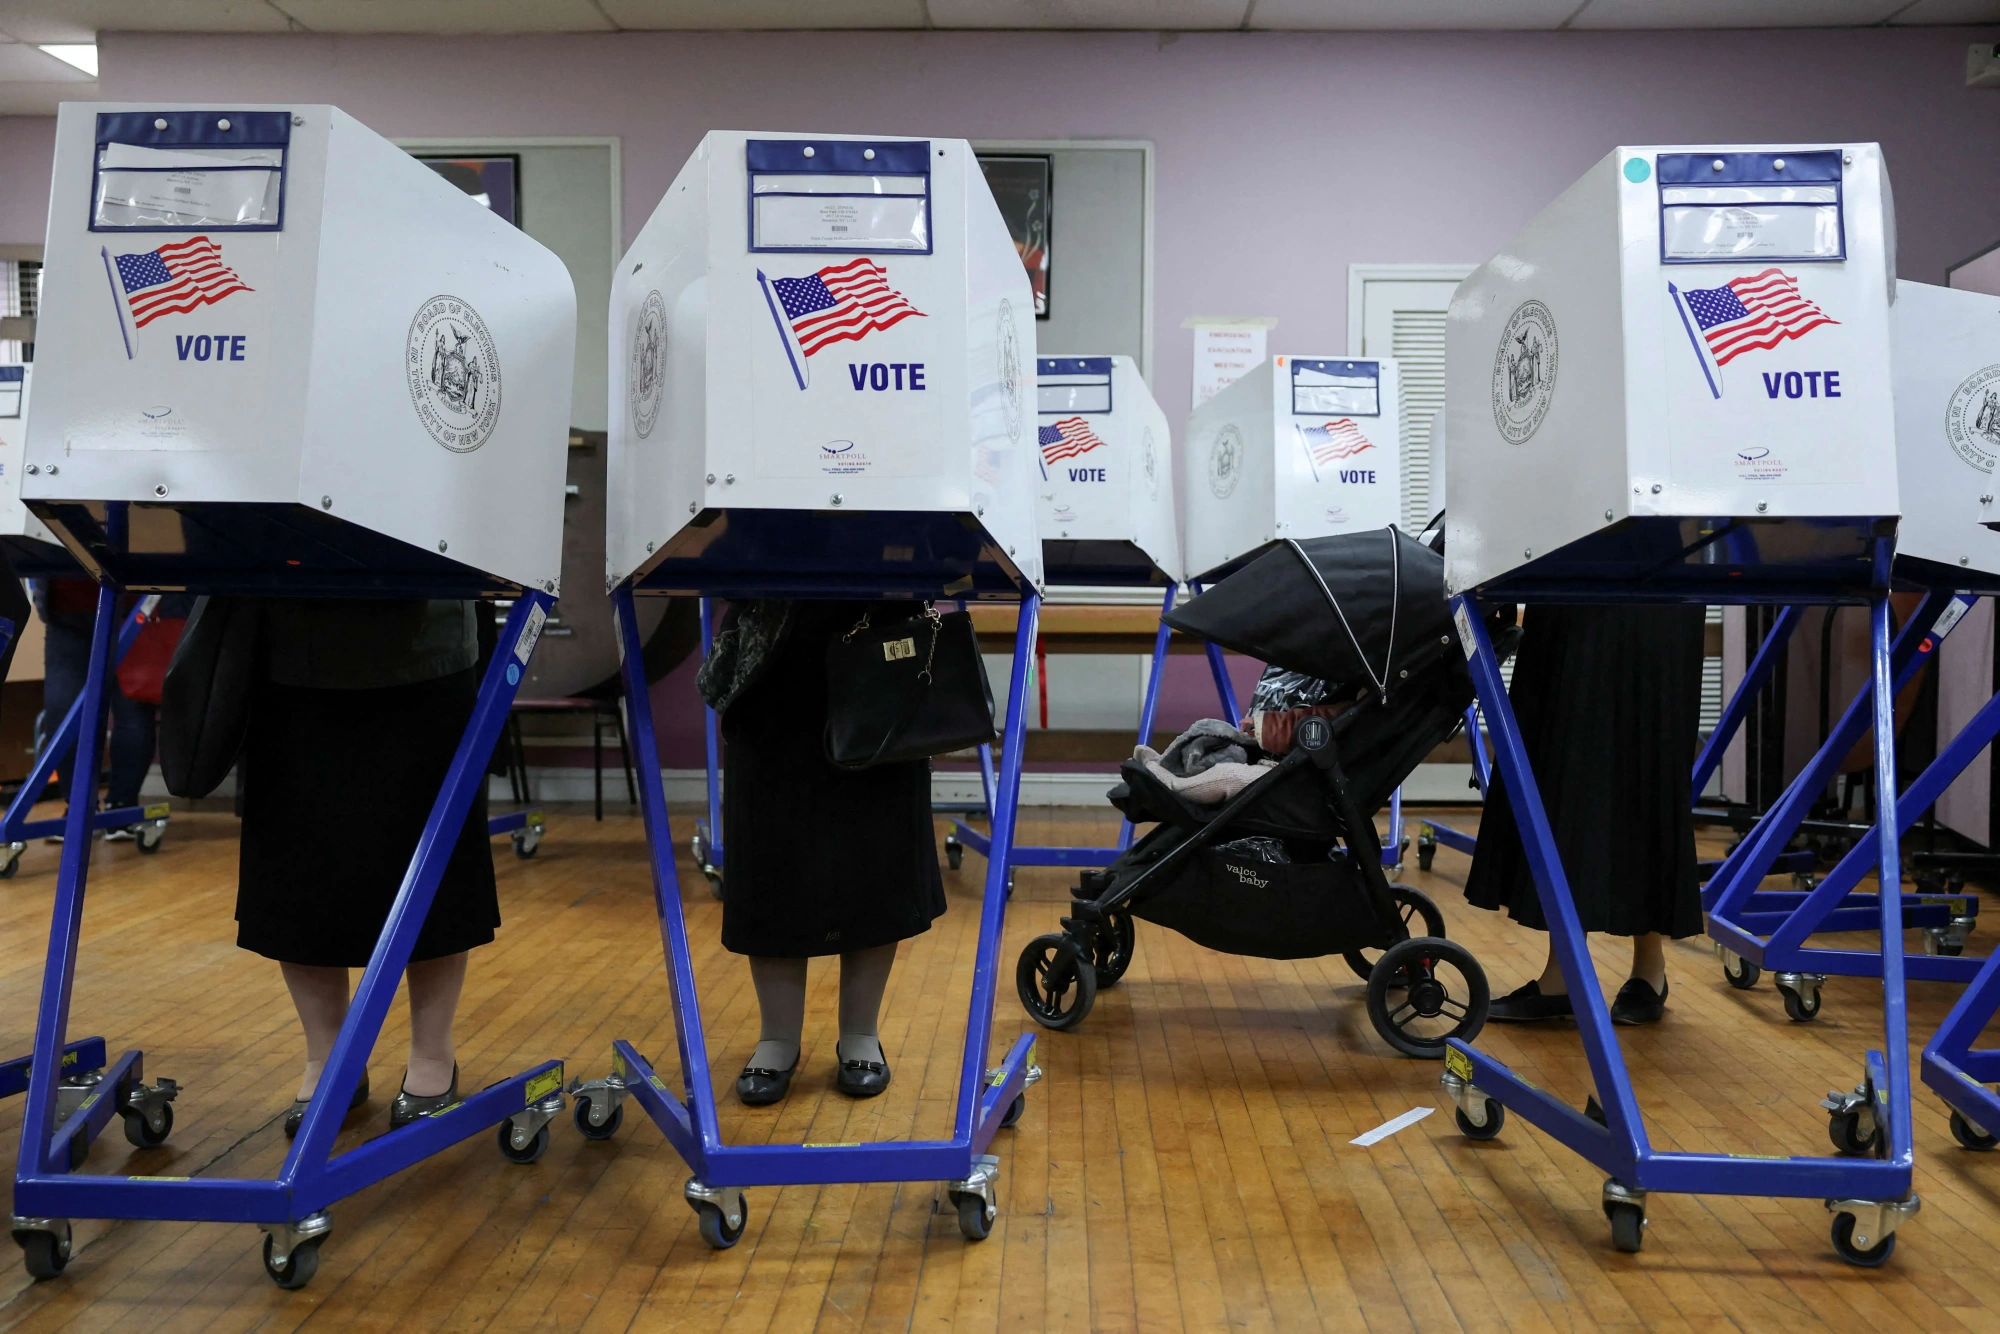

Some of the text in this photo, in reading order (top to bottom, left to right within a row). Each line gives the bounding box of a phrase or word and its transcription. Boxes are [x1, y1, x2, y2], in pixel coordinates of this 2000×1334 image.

[175, 334, 246, 361] VOTE
[417, 302, 497, 382] BOARD OF ELECTIONS
[1496, 306, 1552, 375] BOARD OF ELECTIONS
[410, 347, 419, 363] IN
[411, 368, 424, 400] THE
[848, 362, 926, 391] VOTE
[1762, 371, 1842, 399] VOTE
[1962, 369, 2000, 396] BOARD
[421, 404, 442, 433] CITY
[480, 399, 497, 432] YORK
[1951, 406, 1961, 418] IN
[443, 430, 456, 443] OF
[459, 431, 479, 445] NEW
[1507, 426, 1522, 438] CITY
[1523, 423, 1532, 436] OF
[1951, 420, 1964, 442] THE
[1960, 444, 1985, 464] CITY
[1068, 468, 1106, 482] VOTE
[1340, 470, 1376, 484] VOTE
[1225, 863, 1257, 877] valco
[1239, 874, 1269, 889] baby
